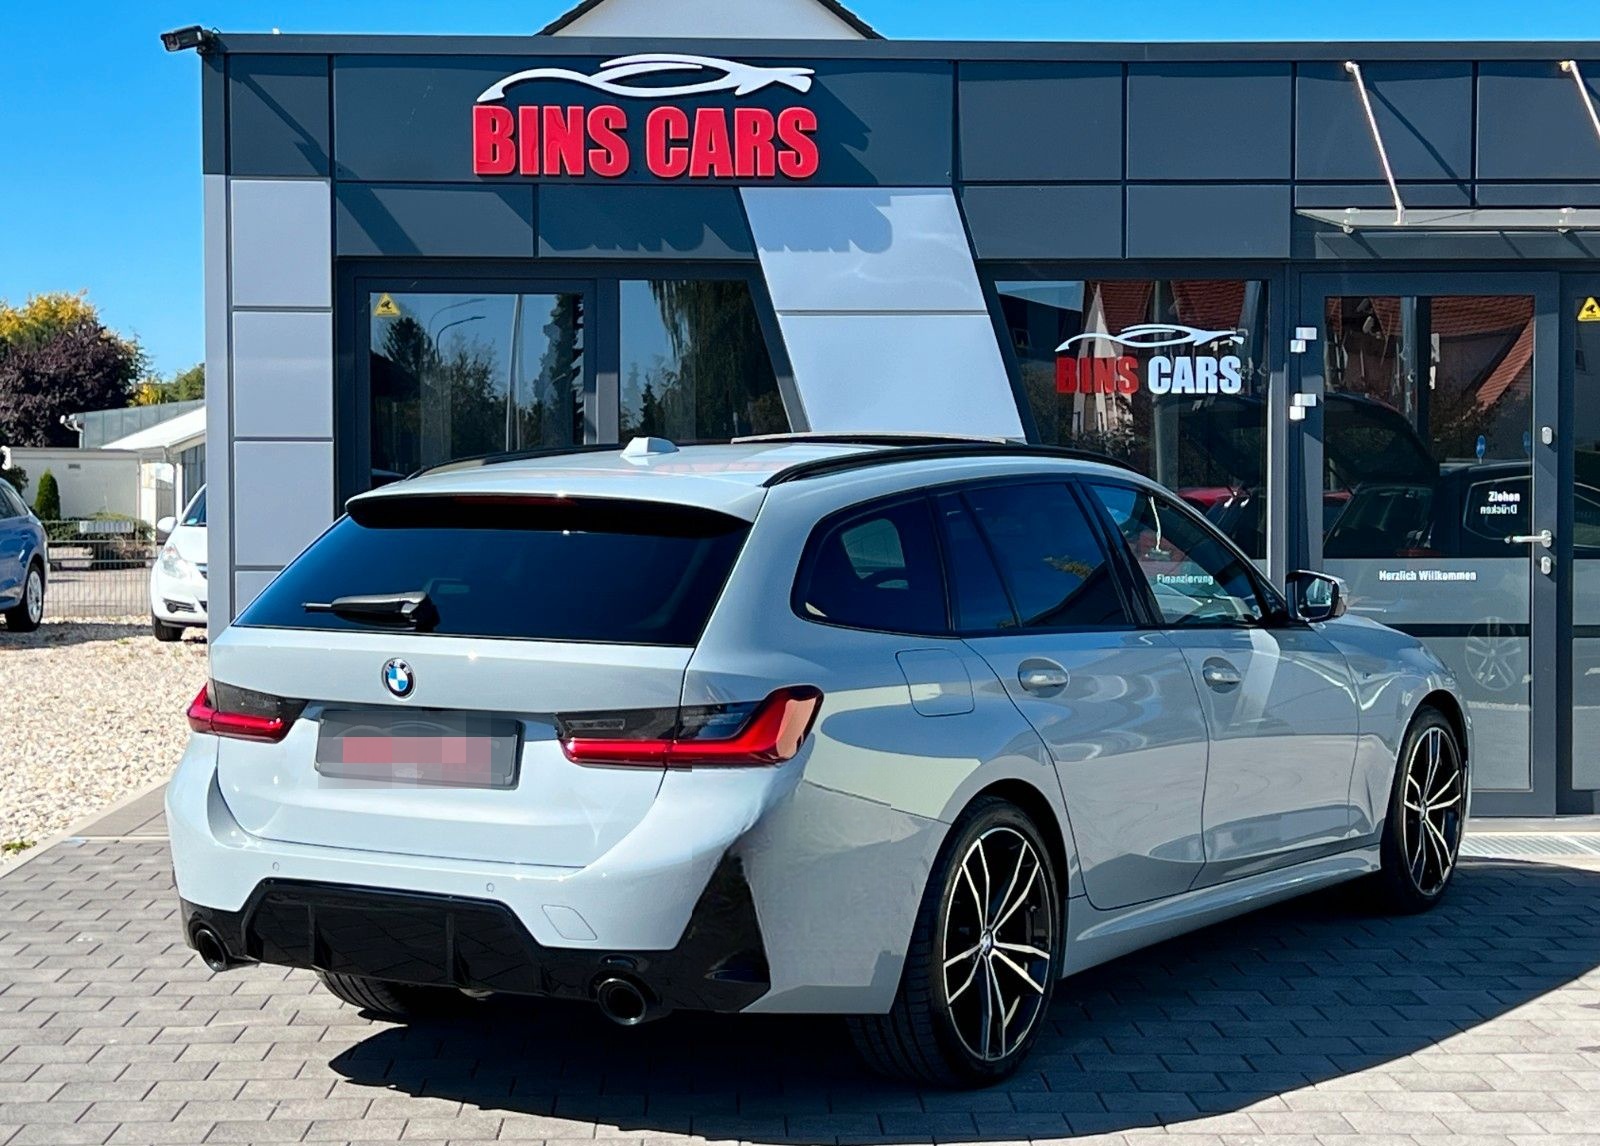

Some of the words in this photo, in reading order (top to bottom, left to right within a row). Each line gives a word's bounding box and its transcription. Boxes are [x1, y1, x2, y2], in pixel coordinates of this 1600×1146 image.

[472, 105, 630, 178] BINS
[646, 106, 819, 178] CARS
[1055, 355, 1140, 394] BINS
[1148, 355, 1242, 394] CARS
[1488, 491, 1520, 502] Ziehen
[1157, 573, 1213, 585] Finanzierung
[1379, 570, 1416, 581] Herzlich
[1419, 570, 1476, 581] Willkommen
